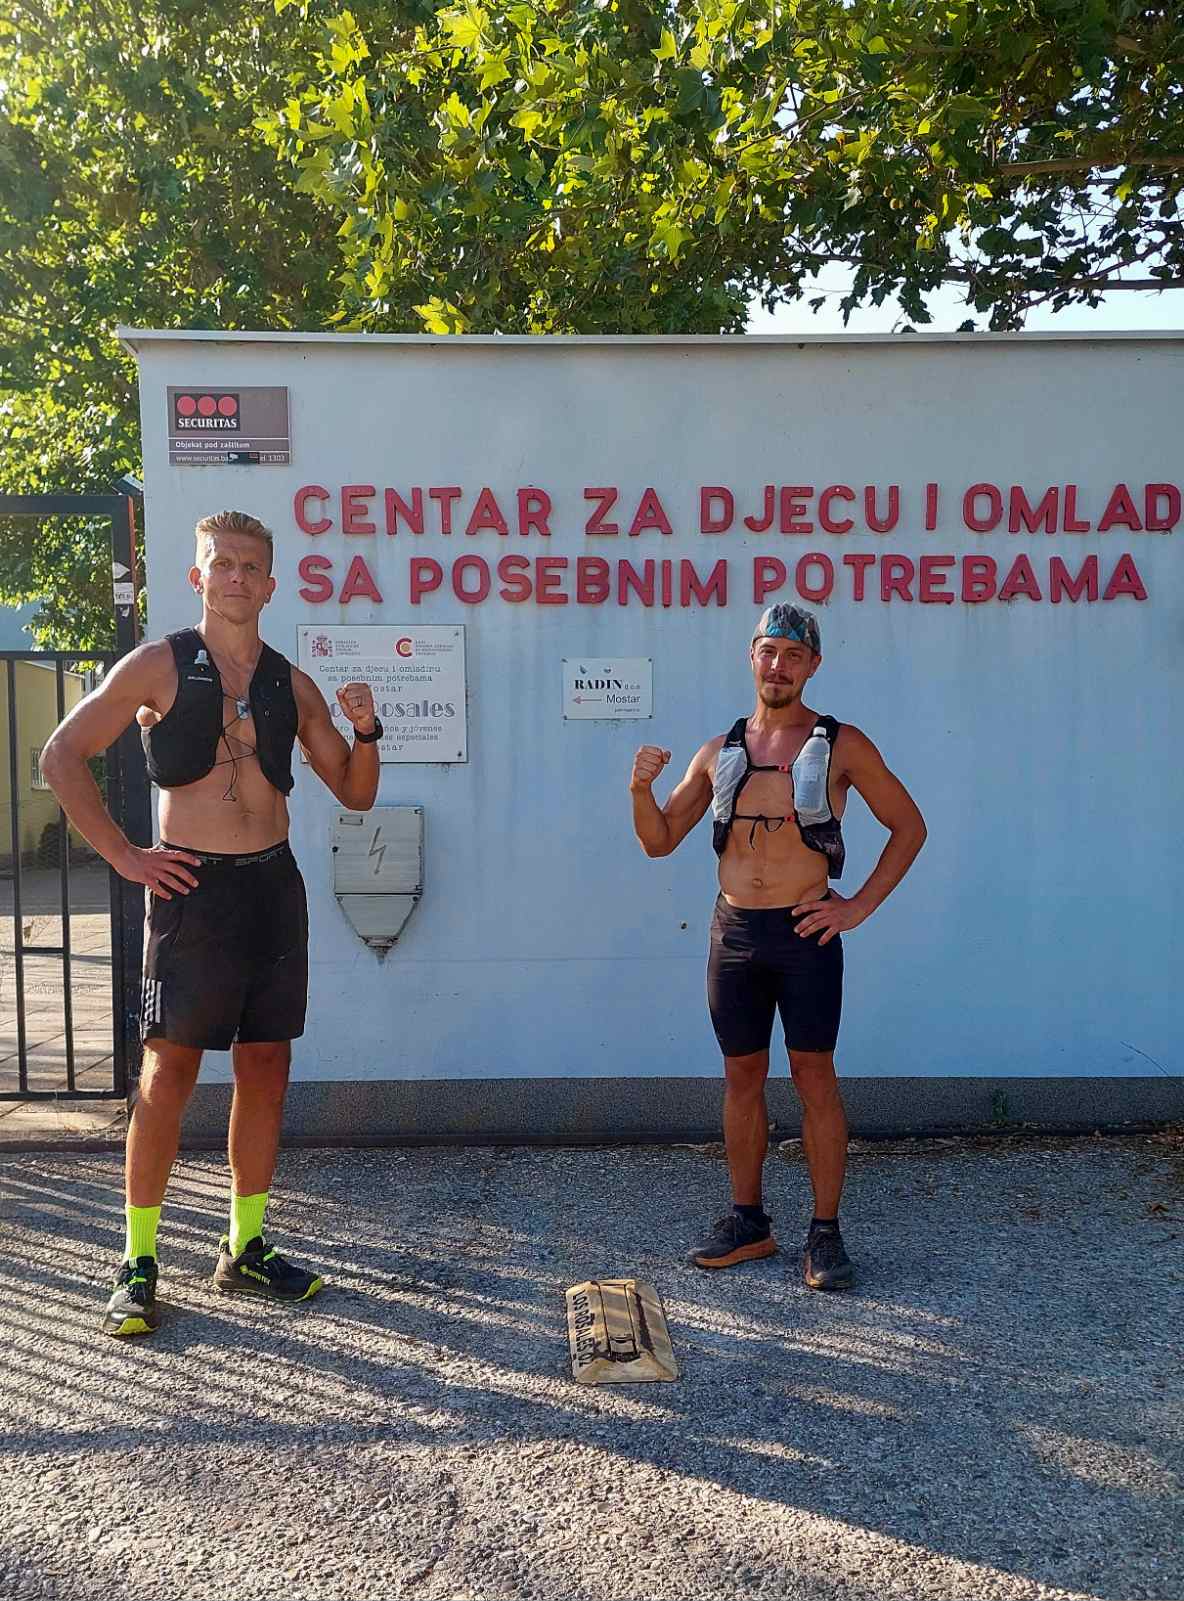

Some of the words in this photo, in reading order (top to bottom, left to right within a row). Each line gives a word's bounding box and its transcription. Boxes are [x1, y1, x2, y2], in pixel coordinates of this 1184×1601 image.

[178, 418, 237, 428] SECURITAS
[176, 441, 203, 449] Objekat
[205, 441, 218, 450] pod
[293, 484, 552, 536] CENTAR
[583, 486, 673, 536] ZA
[700, 484, 900, 533] DJECU
[925, 483, 938, 531] I
[963, 483, 1182, 534] OMLAD
[298, 555, 383, 604] SA
[410, 554, 728, 608] POSEBNIM
[753, 552, 1148, 605] POTREBAMA
[319, 665, 349, 673] Centar
[365, 665, 389, 675] djecu
[341, 674, 383, 683] posebnim
[386, 674, 433, 683] potrebama
[370, 685, 402, 693] ostar
[575, 679, 622, 689] RADIN
[606, 694, 641, 704] Mostar
[573, 1289, 589, 1311] LOS
[574, 1309, 594, 1353] ROSALES
